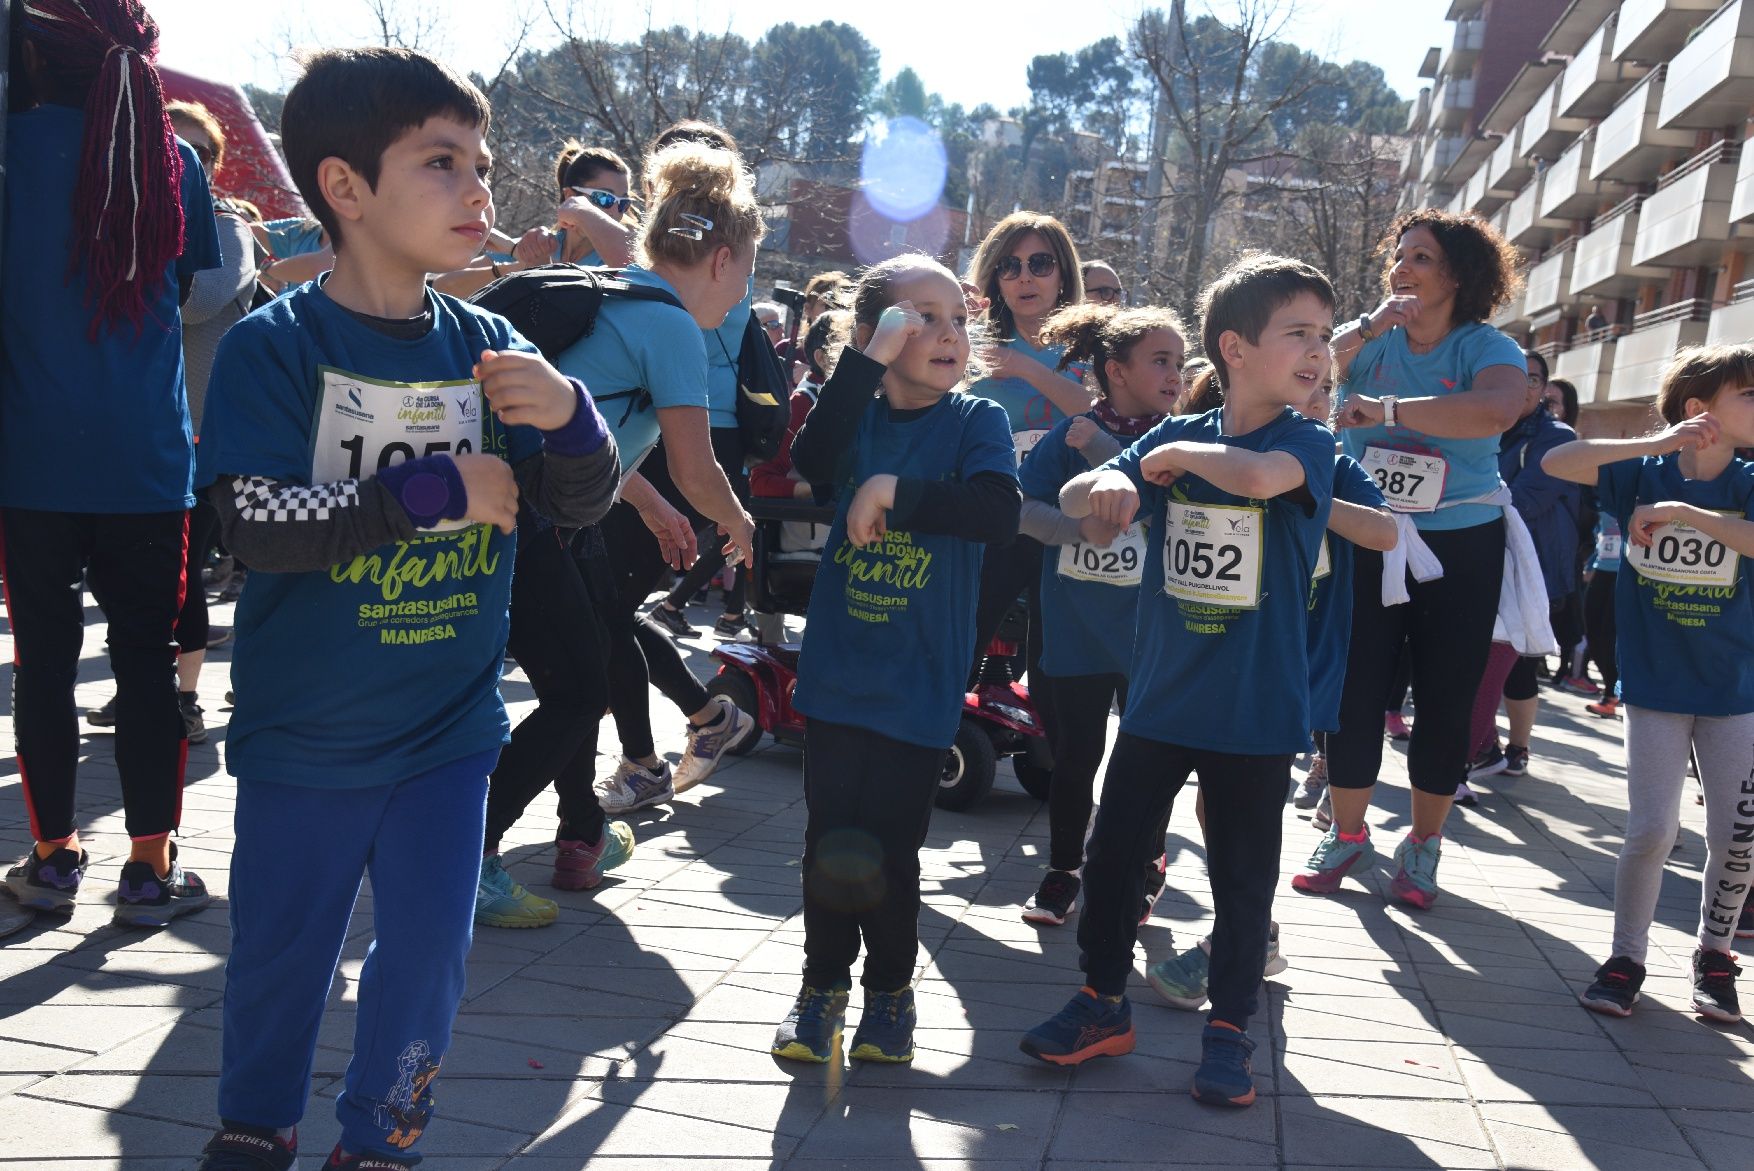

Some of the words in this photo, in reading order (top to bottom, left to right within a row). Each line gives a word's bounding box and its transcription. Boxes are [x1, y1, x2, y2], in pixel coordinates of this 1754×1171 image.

[397, 404, 447, 424] infantil
[456, 392, 477, 417] Vela
[1374, 467, 1425, 497] 387
[884, 530, 912, 544] RSA
[331, 524, 499, 600] infantil
[866, 542, 883, 555] LA
[886, 543, 926, 560] DONA
[1071, 542, 1138, 573] 1029
[1165, 536, 1243, 581] 1052
[359, 592, 478, 618] santasusana
[847, 605, 890, 623] MANRESA
[381, 623, 456, 644] MANRESA
[222, 1133, 274, 1151] SKECHERS
